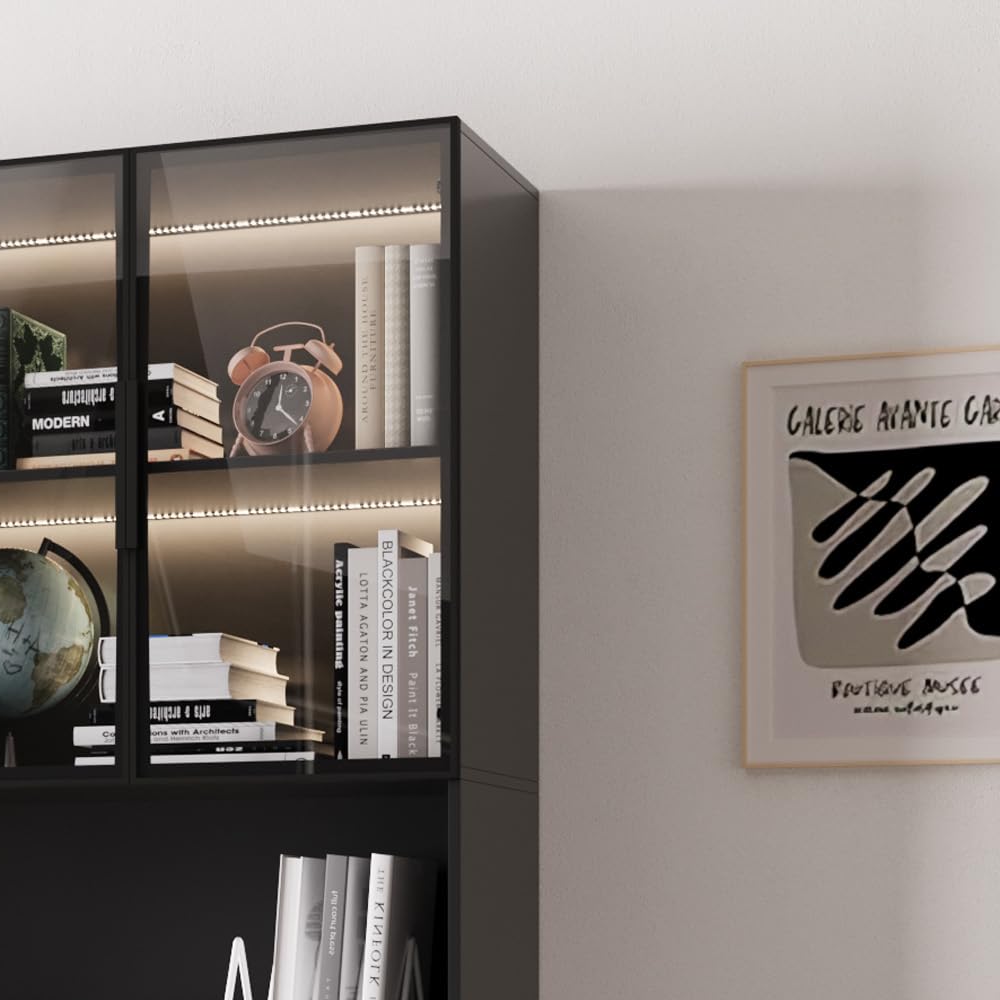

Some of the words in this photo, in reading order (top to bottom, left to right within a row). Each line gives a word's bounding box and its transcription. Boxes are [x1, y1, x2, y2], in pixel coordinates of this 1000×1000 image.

[32, 415, 90, 431] MODERN
[334, 559, 345, 607] Acrylic
[359, 572, 369, 609] LOTTA
[382, 540, 393, 640] BLACKCOLOR
[408, 585, 419, 621] Janet
[334, 609, 345, 670] painting
[359, 614, 369, 663] AGATON
[382, 644, 393, 659] IN
[408, 626, 419, 658] Fitch
[359, 667, 369, 691] AND
[382, 663, 393, 720] DESIGN
[408, 672, 419, 703] Paint
[194, 705, 211, 720] arts
[359, 696, 369, 714] PIA
[408, 708, 419, 718] It
[171, 728, 190, 736] with
[193, 727, 240, 735] Architects
[359, 719, 369, 746] ULIN
[408, 723, 419, 756] Black
